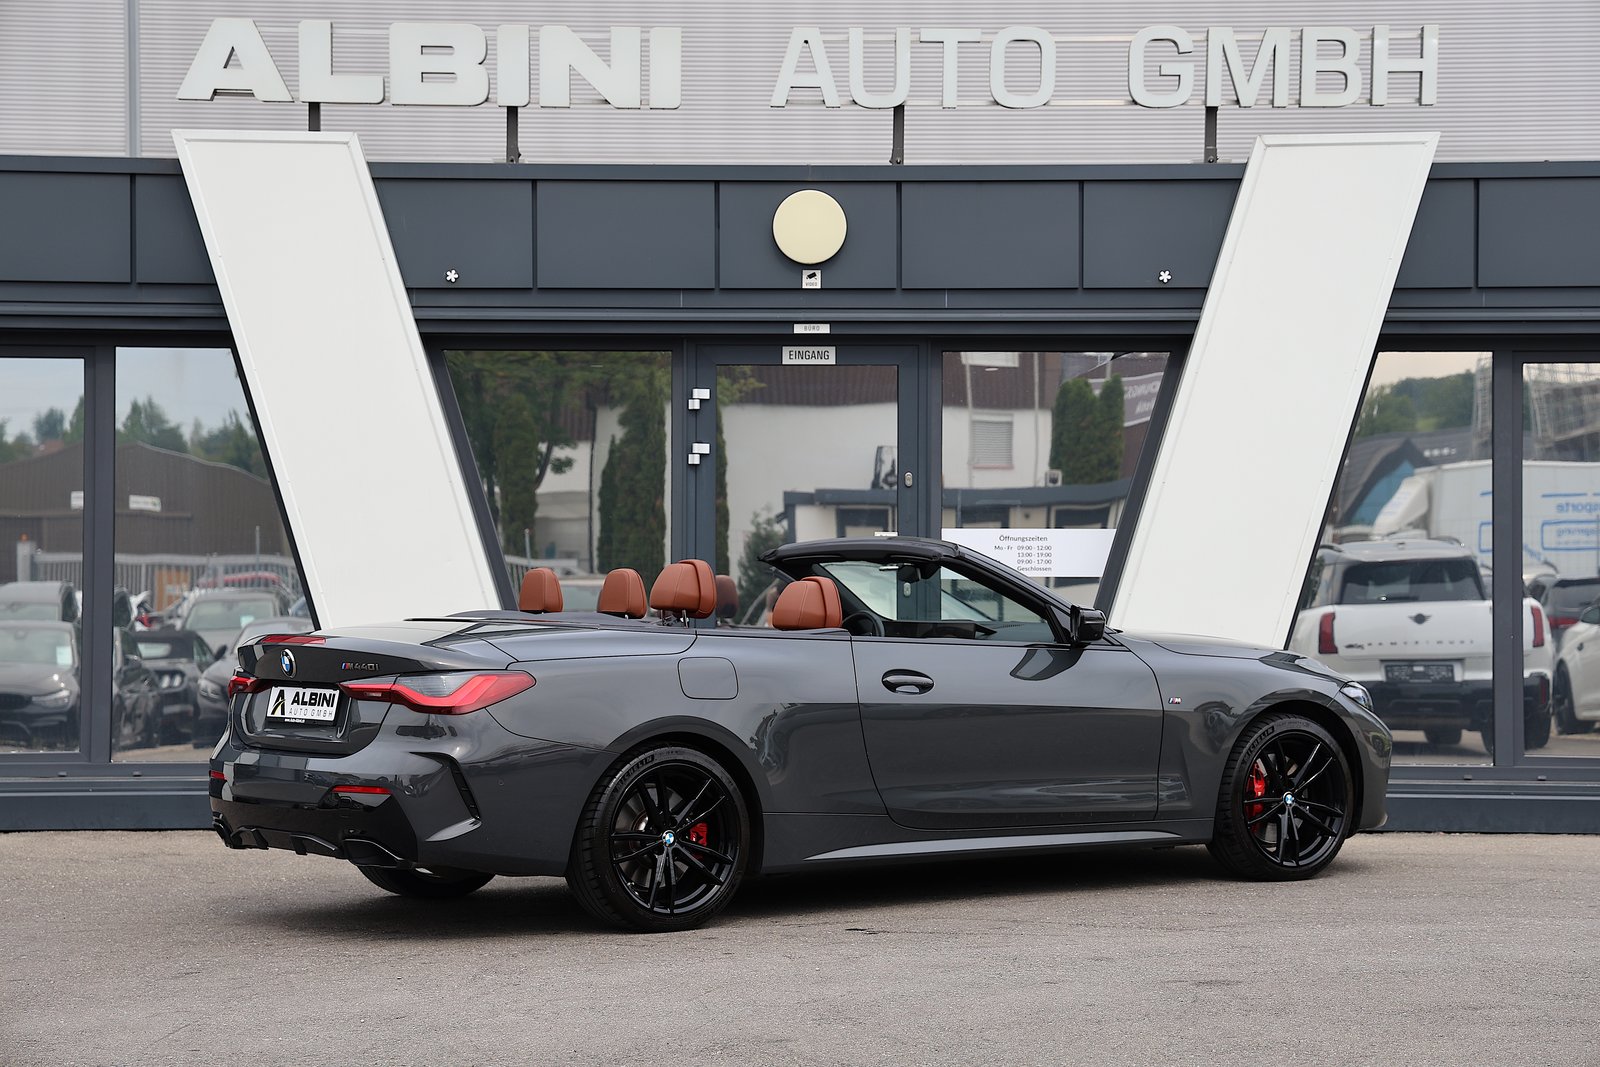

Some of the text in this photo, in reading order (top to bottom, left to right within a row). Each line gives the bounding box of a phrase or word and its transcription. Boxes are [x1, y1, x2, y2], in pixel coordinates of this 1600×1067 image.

[177, 17, 1439, 109] ALBINI AUTO GMBH
[804, 324, 820, 332] BÜRO
[788, 350, 830, 360] EINGANG
[291, 691, 336, 707] ALBINI
[289, 708, 333, 718] AUTO GMBH
